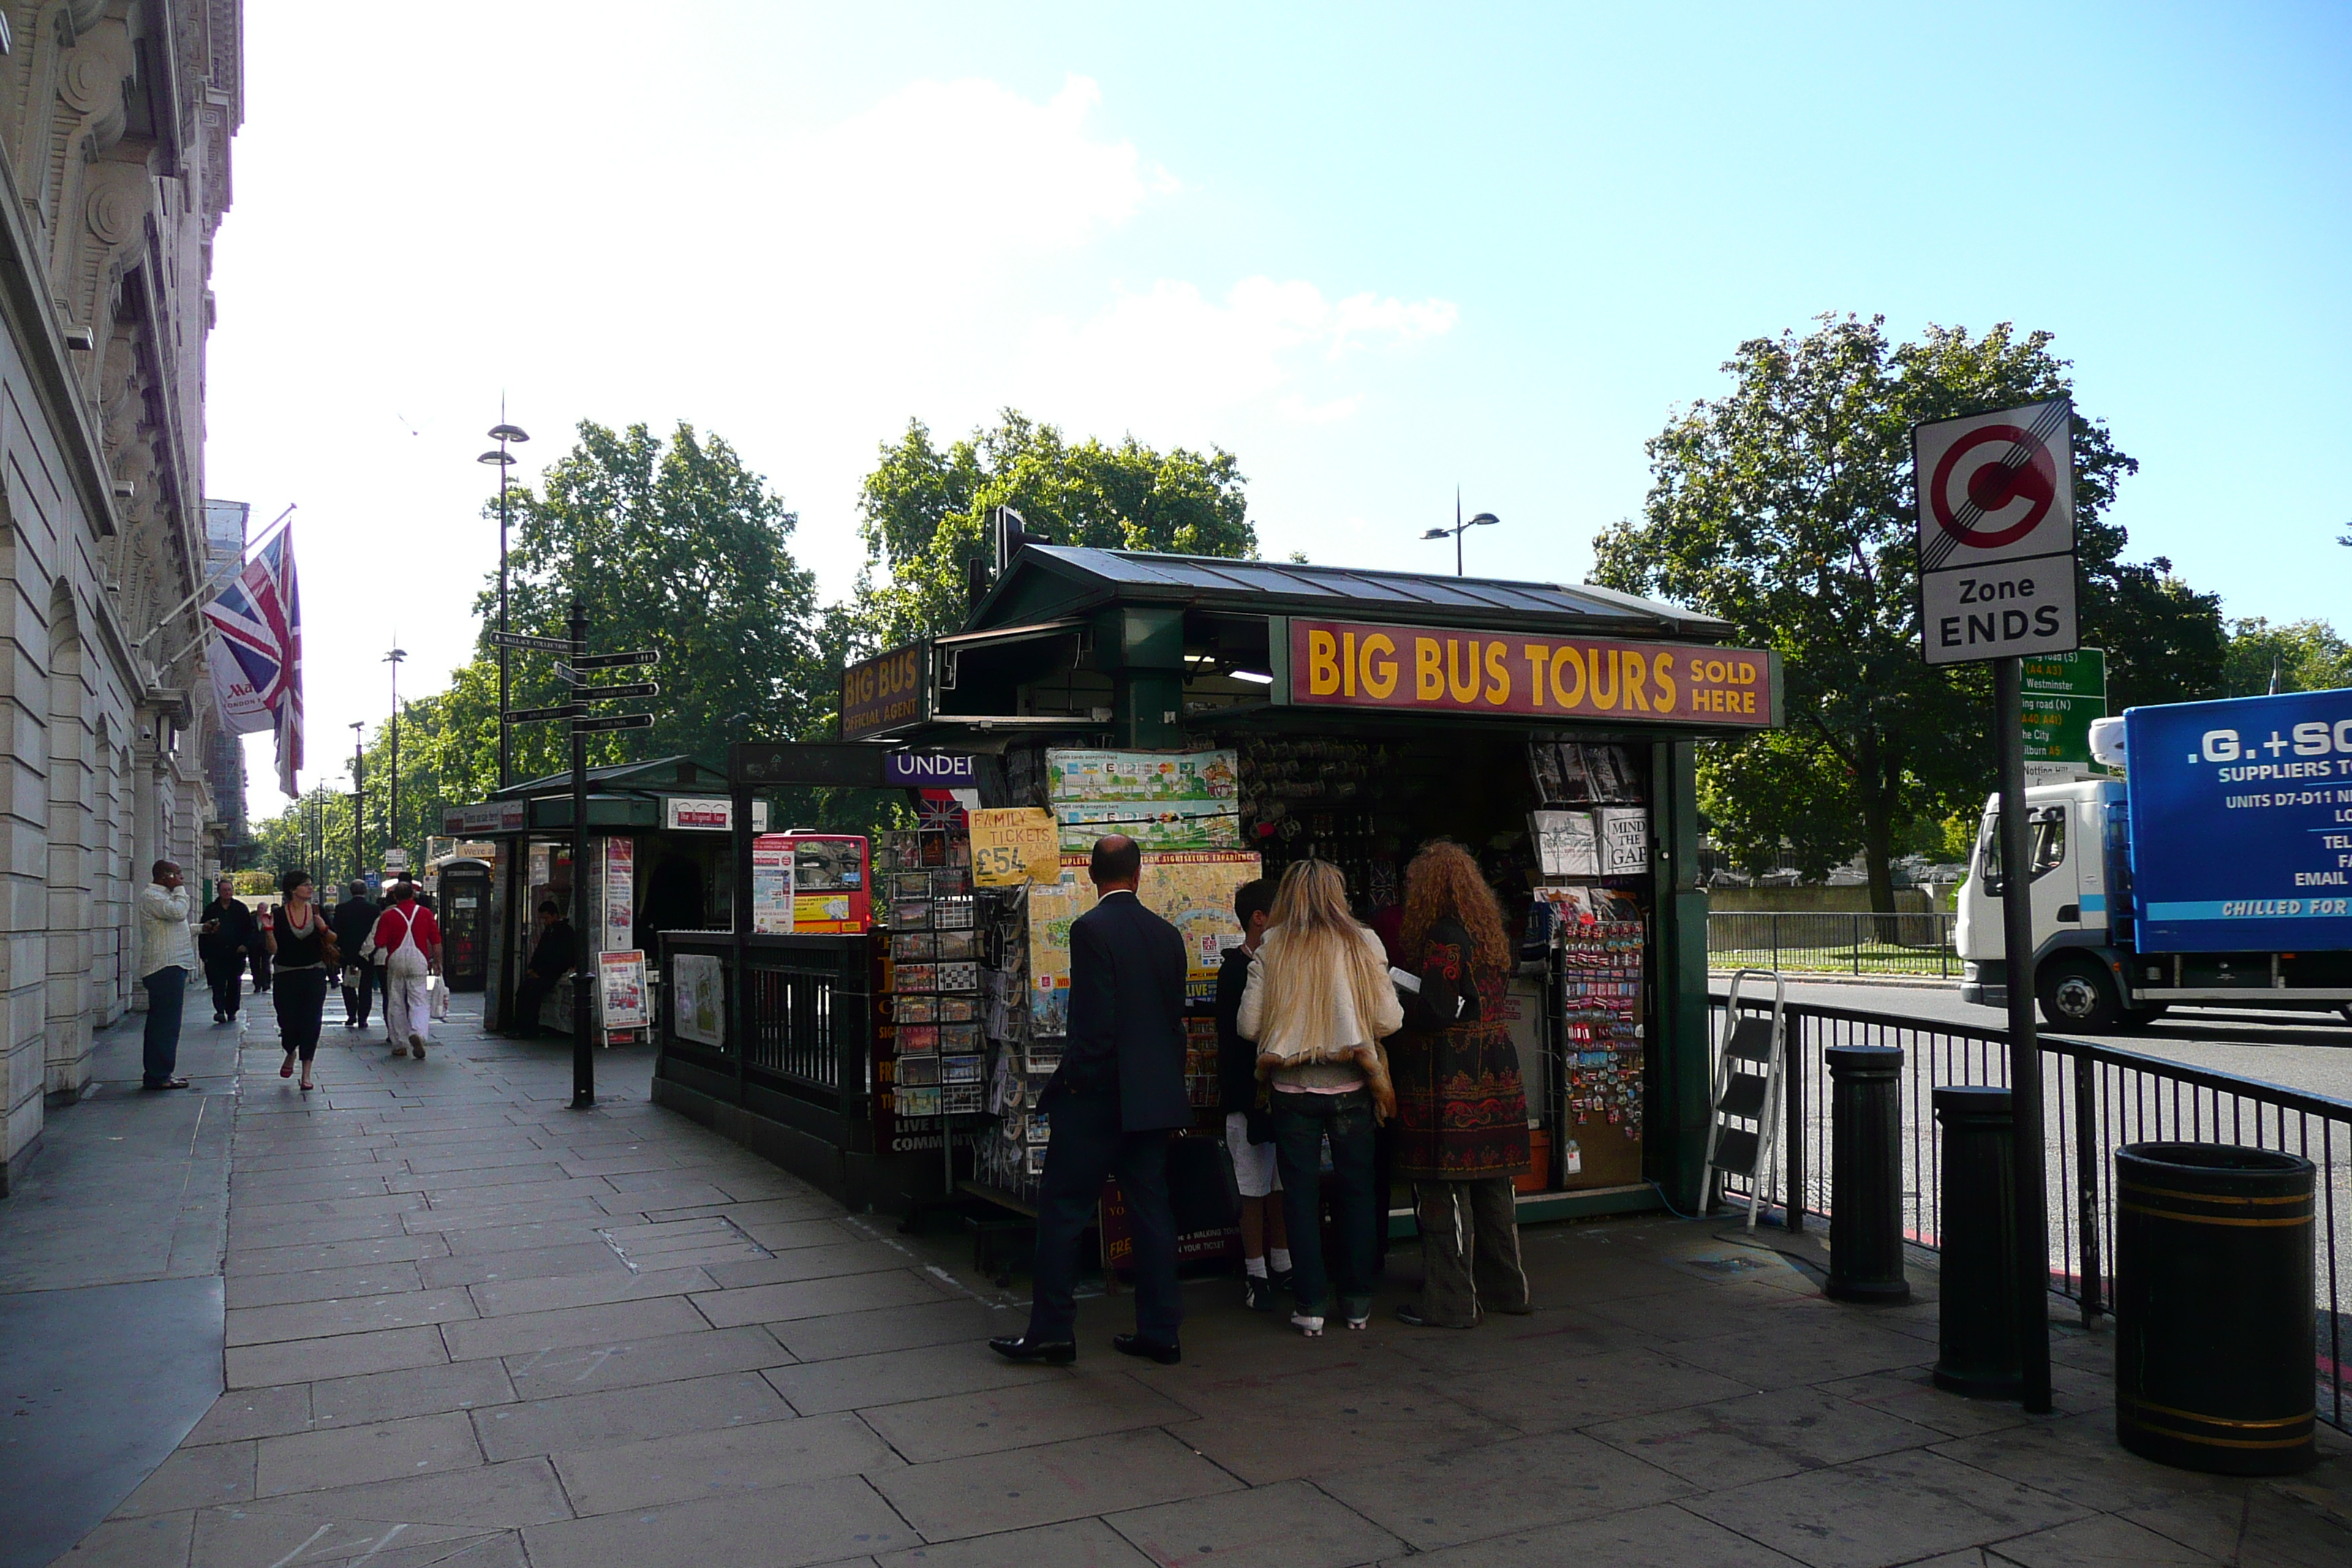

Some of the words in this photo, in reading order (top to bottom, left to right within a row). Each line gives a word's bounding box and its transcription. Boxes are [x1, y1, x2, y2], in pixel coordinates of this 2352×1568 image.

[1959, 578, 2035, 604] Zone
[1940, 605, 2059, 647] ENDS
[504, 636, 531, 645] WALLACE
[533, 641, 568, 649] COLLECTION
[1308, 630, 1398, 699] BIG
[1415, 637, 1511, 705] BUS
[1524, 644, 1676, 713] TOURS
[1691, 659, 1756, 685] SOLD
[2046, 665, 2062, 676] A3)
[845, 666, 874, 709] BIG
[878, 650, 916, 698] BUS
[2027, 678, 2074, 690] Westminster
[1692, 689, 1756, 714] HERE
[2022, 699, 2033, 710] ing
[2036, 698, 2054, 710] road
[2056, 698, 2071, 712] (N)
[844, 709, 881, 731] OFFICIAL
[883, 698, 917, 722] AGENT
[2022, 729, 2032, 739] he
[2034, 730, 2050, 742] City
[2024, 745, 2047, 755] ilburn
[2048, 746, 2061, 755] A5
[2218, 761, 2332, 783] SUPPLIERS
[2336, 759, 2352, 774] T
[2225, 794, 2271, 809] UNITS
[2274, 791, 2332, 806] D7-D11
[2337, 789, 2352, 803] N
[752, 818, 764, 826] ere!
[974, 811, 1026, 827] FAMILY
[1612, 821, 1646, 835] MIND
[990, 828, 1050, 845] TICKETS
[1617, 834, 1641, 846] THE
[464, 847, 486, 856] We're
[1163, 854, 1210, 863] SIGHTSEEING
[1213, 853, 1255, 862] EXPERIENCE
[976, 847, 1026, 875] £54
[2295, 871, 2349, 886] EMAIL
[2222, 900, 2302, 917] CHILLED
[2310, 899, 2348, 915] FOR
[1186, 984, 1207, 997] LIVE
[901, 1025, 938, 1033] LONDON
[894, 1118, 930, 1134] LIVE
[1193, 1228, 1222, 1240] WALKING
[1183, 1243, 1202, 1253] YOUR
[1203, 1240, 1225, 1251] TICKET
